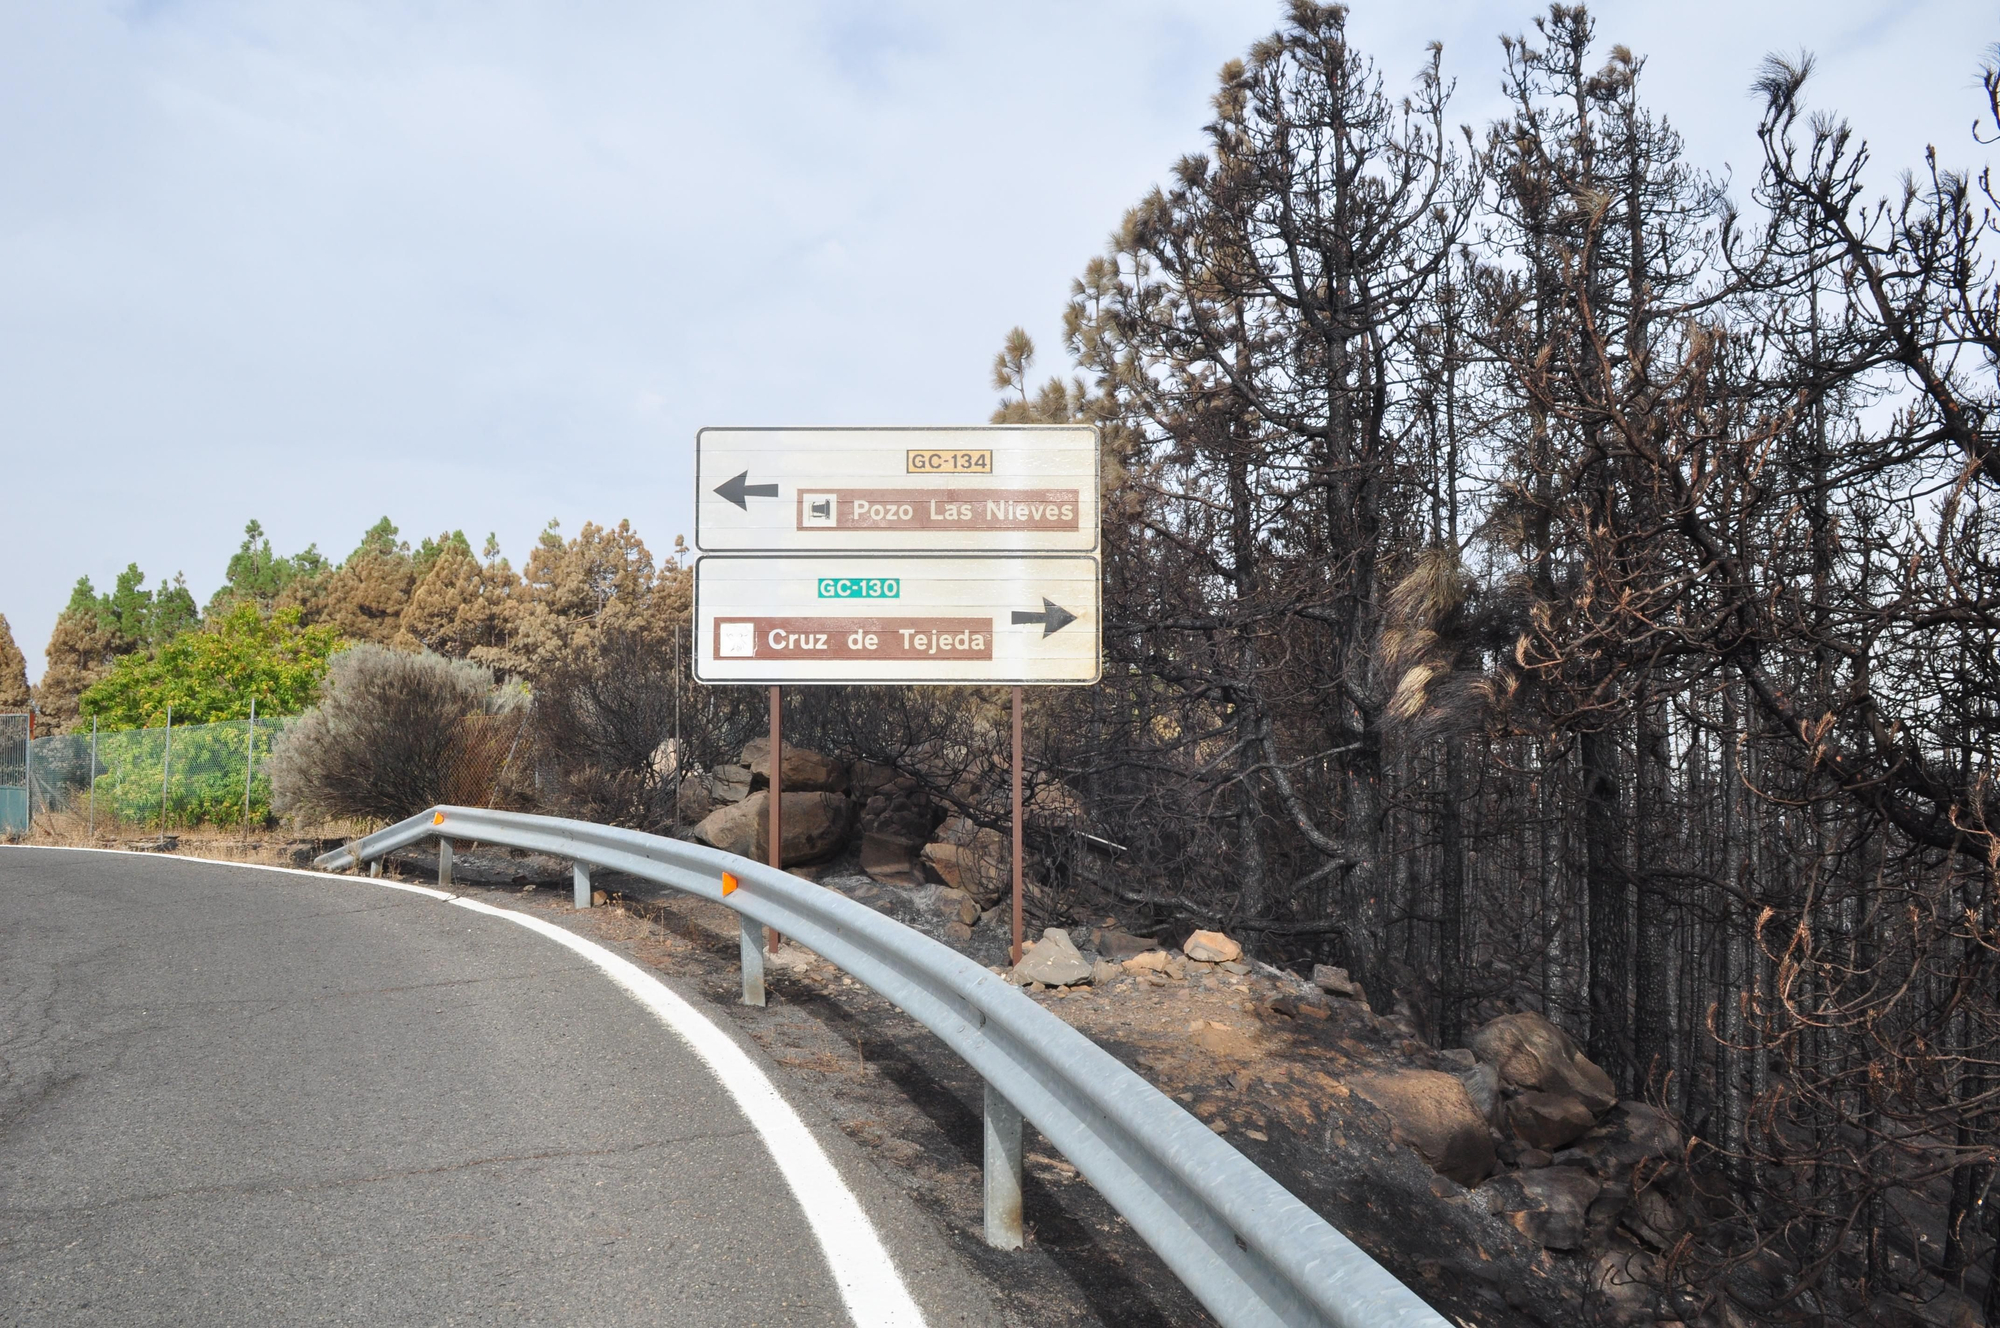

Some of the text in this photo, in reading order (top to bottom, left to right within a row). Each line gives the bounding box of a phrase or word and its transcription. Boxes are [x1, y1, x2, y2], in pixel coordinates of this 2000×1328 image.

[911, 454, 988, 470] GC-134
[853, 500, 1074, 521] Pozo Las Nieves
[820, 580, 898, 597] GC-130
[768, 629, 985, 654] Cruz de Tejeda
